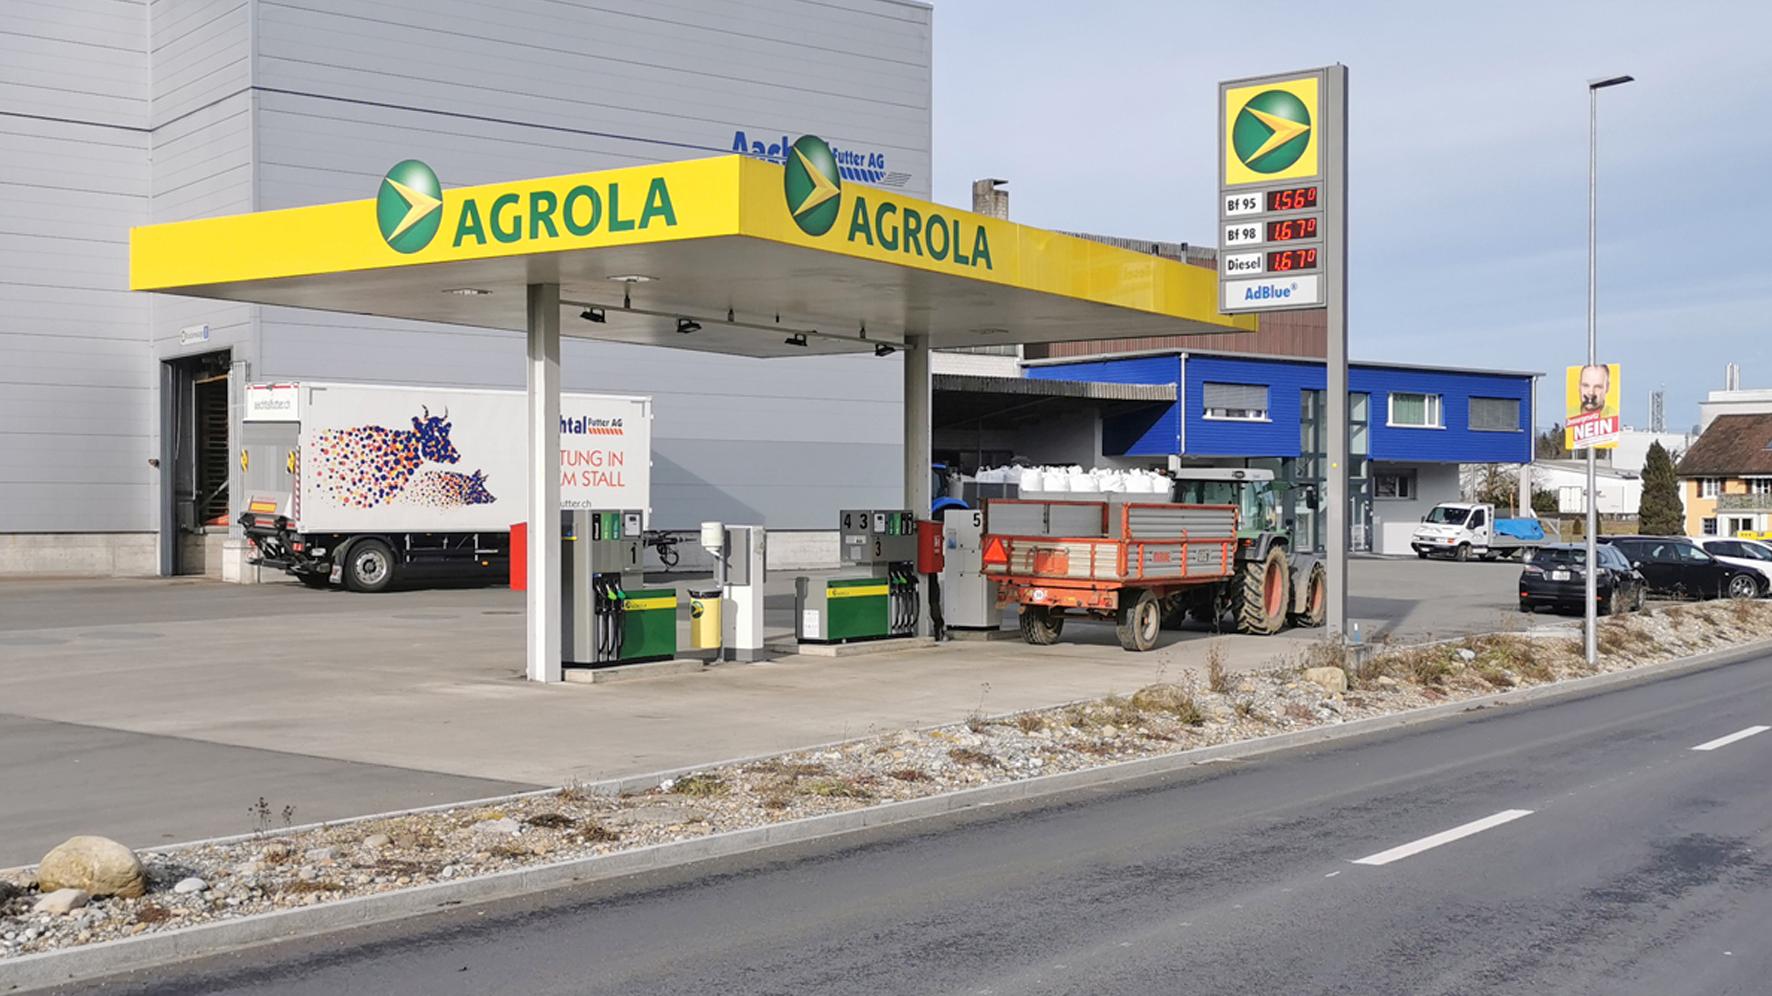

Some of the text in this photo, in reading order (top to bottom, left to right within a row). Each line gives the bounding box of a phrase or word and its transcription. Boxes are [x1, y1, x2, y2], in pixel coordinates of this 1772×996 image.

[868, 152, 885, 169] AG
[453, 176, 678, 248] AGROLA
[1227, 197, 1257, 211] Bf 95
[847, 196, 994, 271] AGROLA
[1227, 227, 1257, 241] Bf 98
[1227, 256, 1261, 271] Diesel
[560, 415, 587, 434] htal
[611, 418, 623, 427] AG
[1574, 417, 1614, 441] NEIN
[560, 449, 624, 467] TUNG IN
[561, 470, 625, 487] M STALL
[560, 499, 592, 508] utter.ch
[843, 513, 868, 530] 4 3
[973, 512, 981, 527] 5
[630, 546, 636, 565] 1
[875, 541, 882, 557] 3
